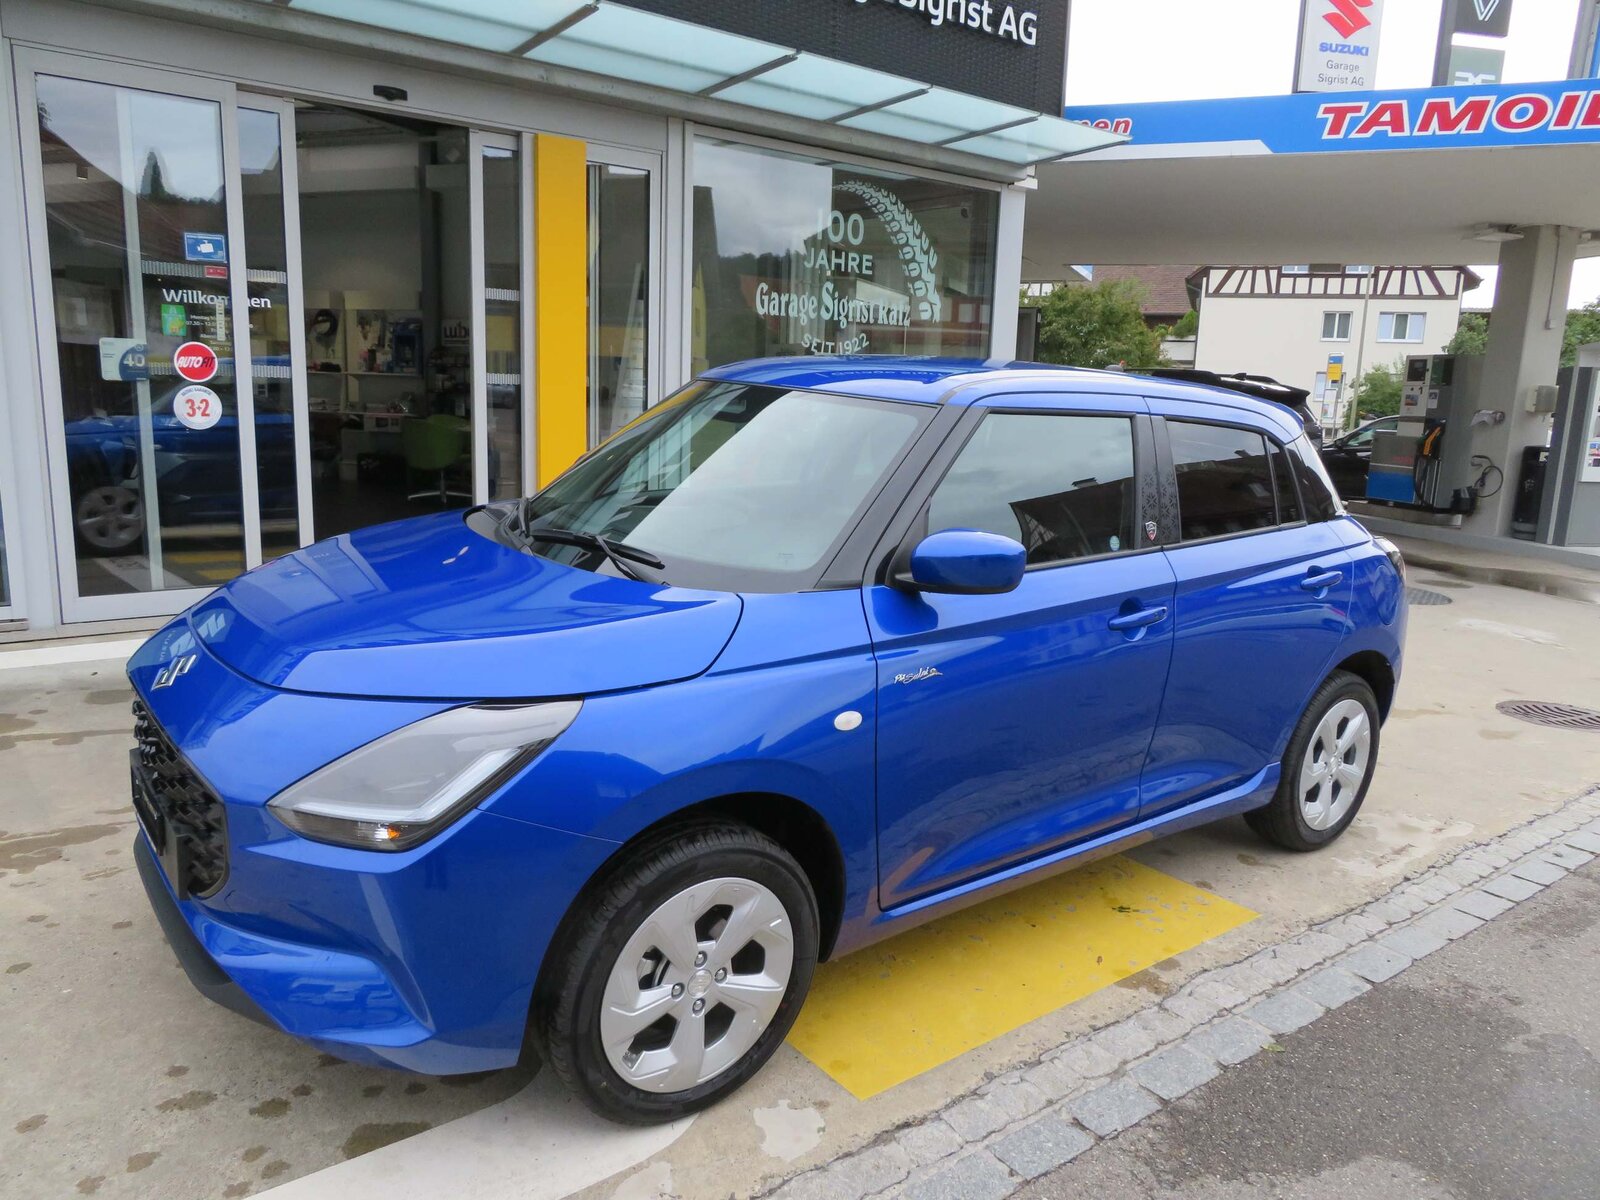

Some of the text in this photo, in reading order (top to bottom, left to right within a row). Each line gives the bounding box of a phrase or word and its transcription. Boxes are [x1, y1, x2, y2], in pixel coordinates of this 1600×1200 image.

[998, 6, 1037, 45] AG
[1319, 42, 1369, 56] SUZUKI
[1326, 60, 1360, 73] Garage
[1317, 73, 1364, 86] Sigrist AG
[816, 208, 864, 246] 100
[804, 247, 873, 275] JAHRE
[755, 282, 818, 326] Garage
[820, 281, 875, 329] Sigrist
[801, 333, 870, 355] SEIT 1922
[123, 353, 145, 367] 40
